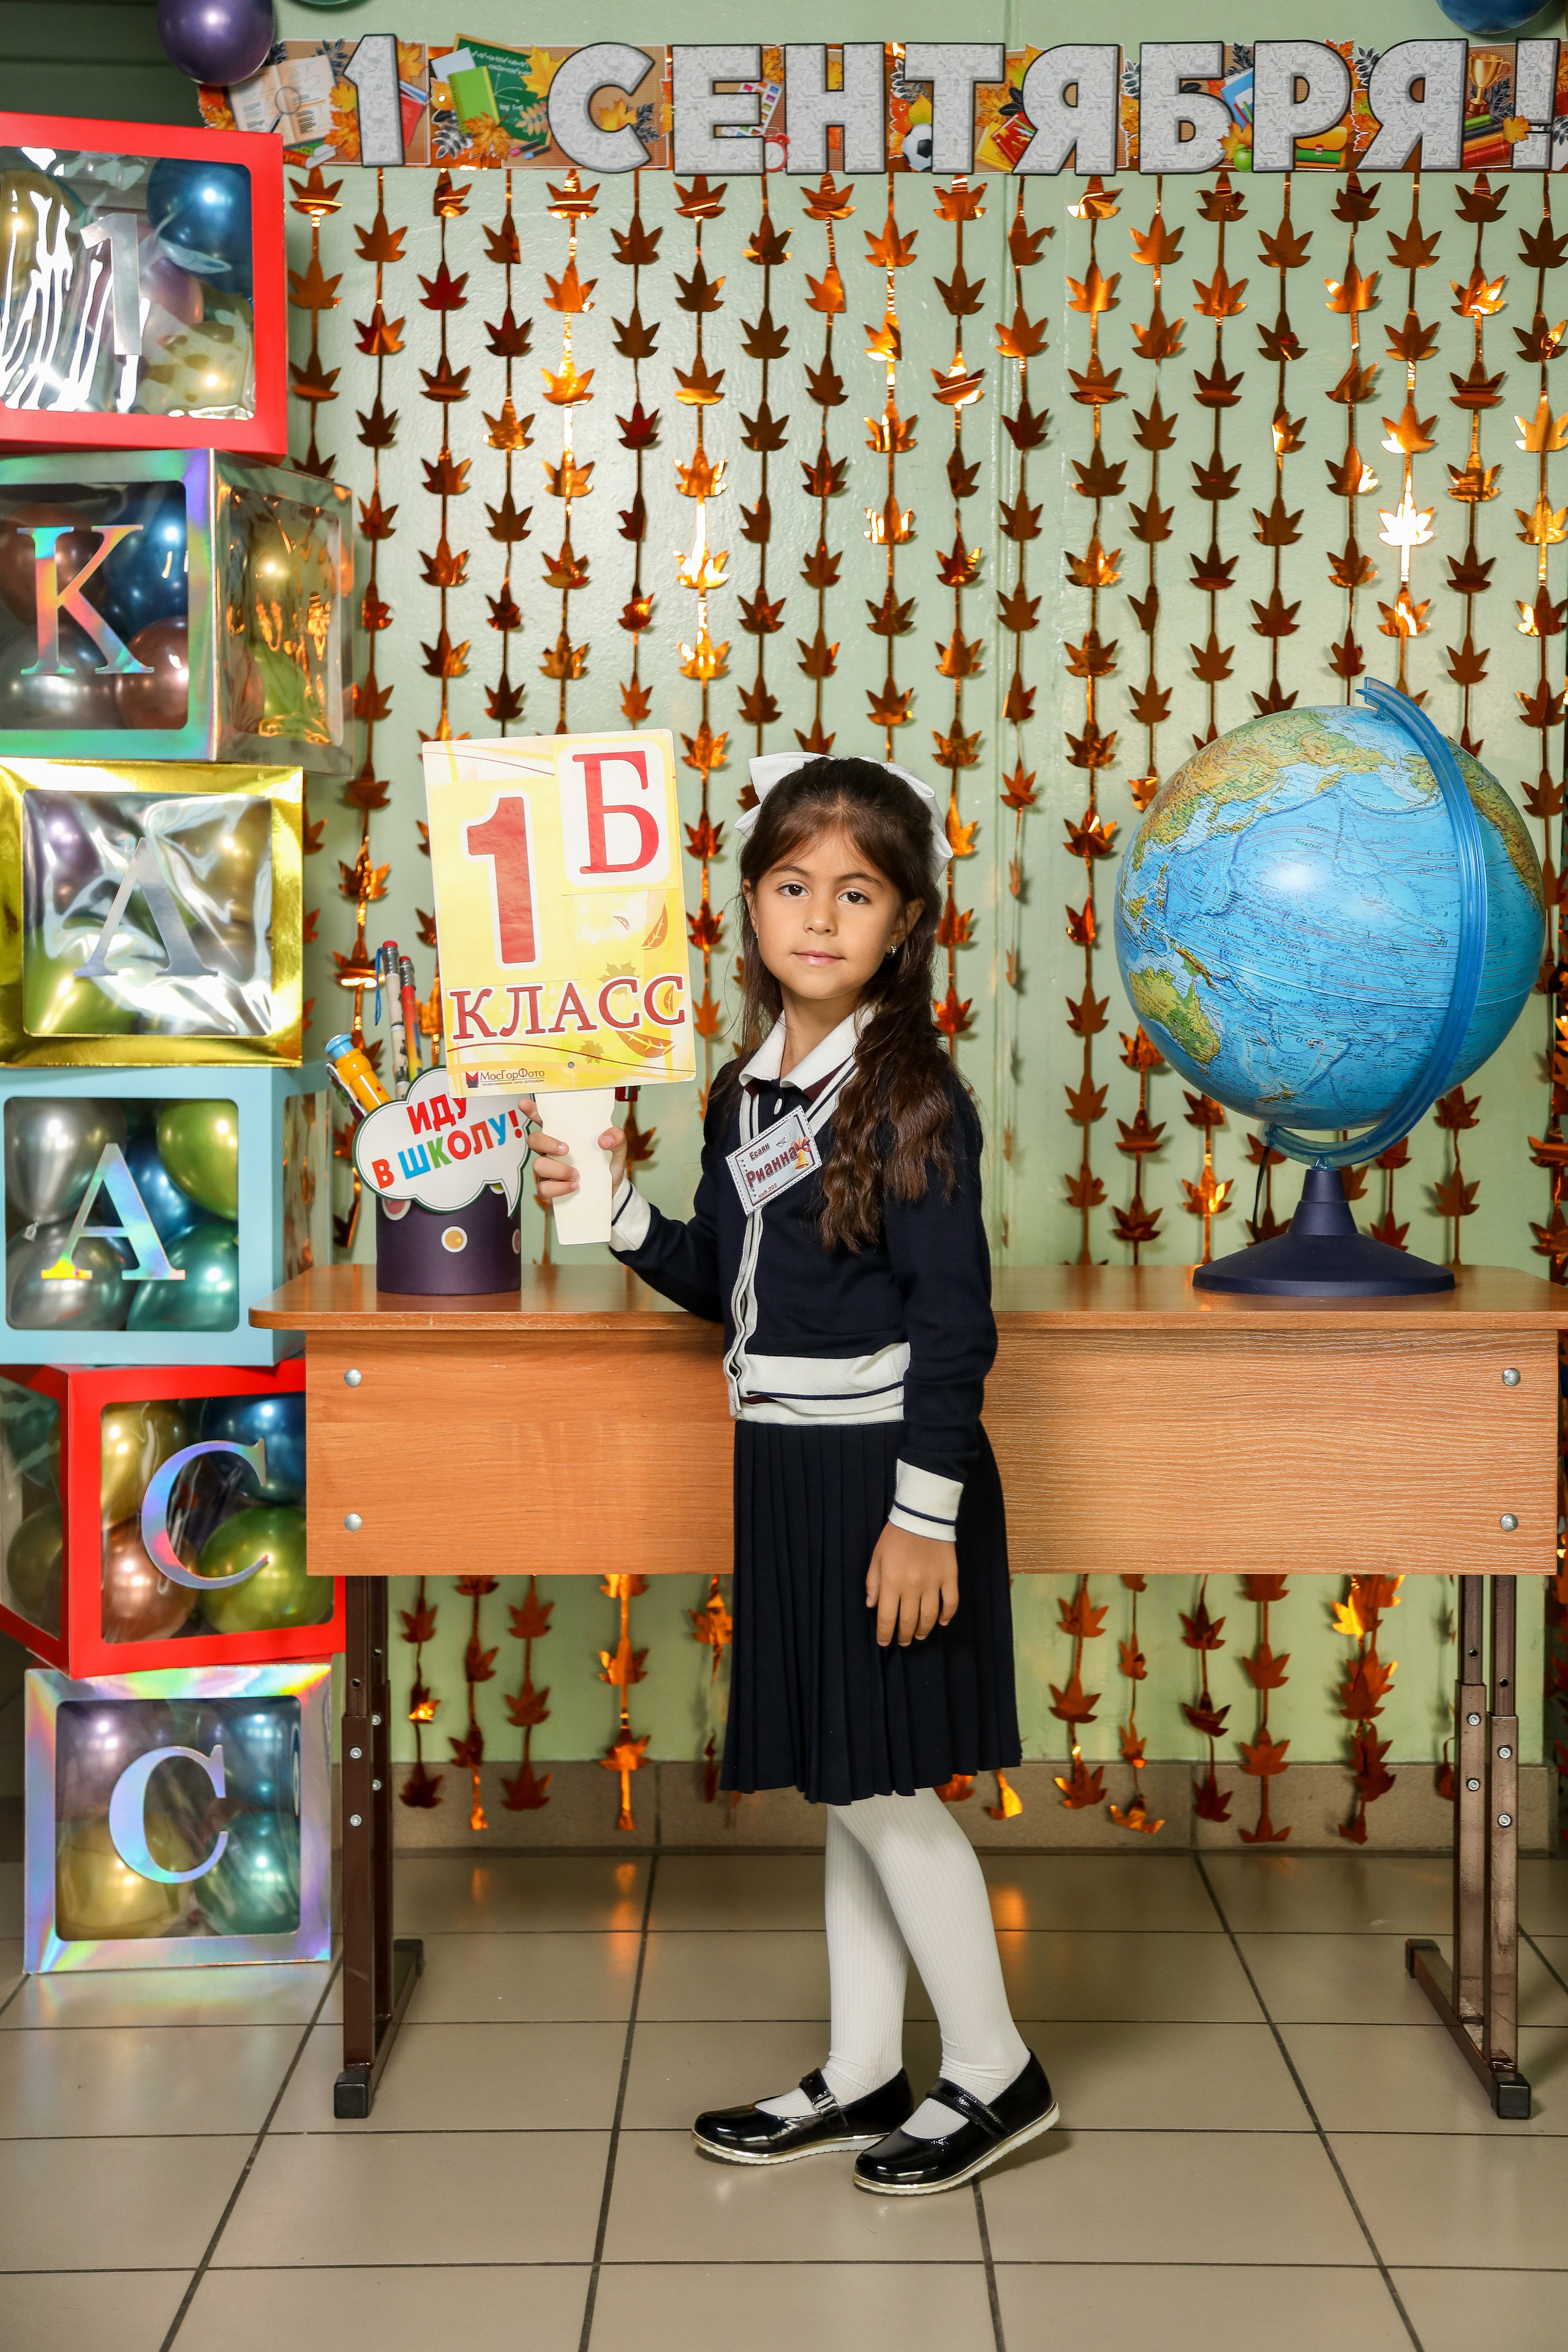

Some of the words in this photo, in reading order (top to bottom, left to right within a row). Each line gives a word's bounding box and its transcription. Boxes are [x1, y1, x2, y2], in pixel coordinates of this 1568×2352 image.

[341, 32, 405, 168] 1
[547, 37, 1560, 175] СЕНТЯБРЯ!
[80, 213, 143, 355] 1
[467, 796, 536, 964] 1
[572, 750, 660, 875] Б
[450, 975, 685, 1040] КЛАСС
[480, 1068, 545, 1081] МосГорФото
[407, 1093, 466, 1135] ИДУ
[372, 1158, 395, 1189] В
[398, 1110, 522, 1180] ШКОЛУ!
[745, 1146, 798, 1187] Рианна
[749, 1143, 771, 1161] Есаян
